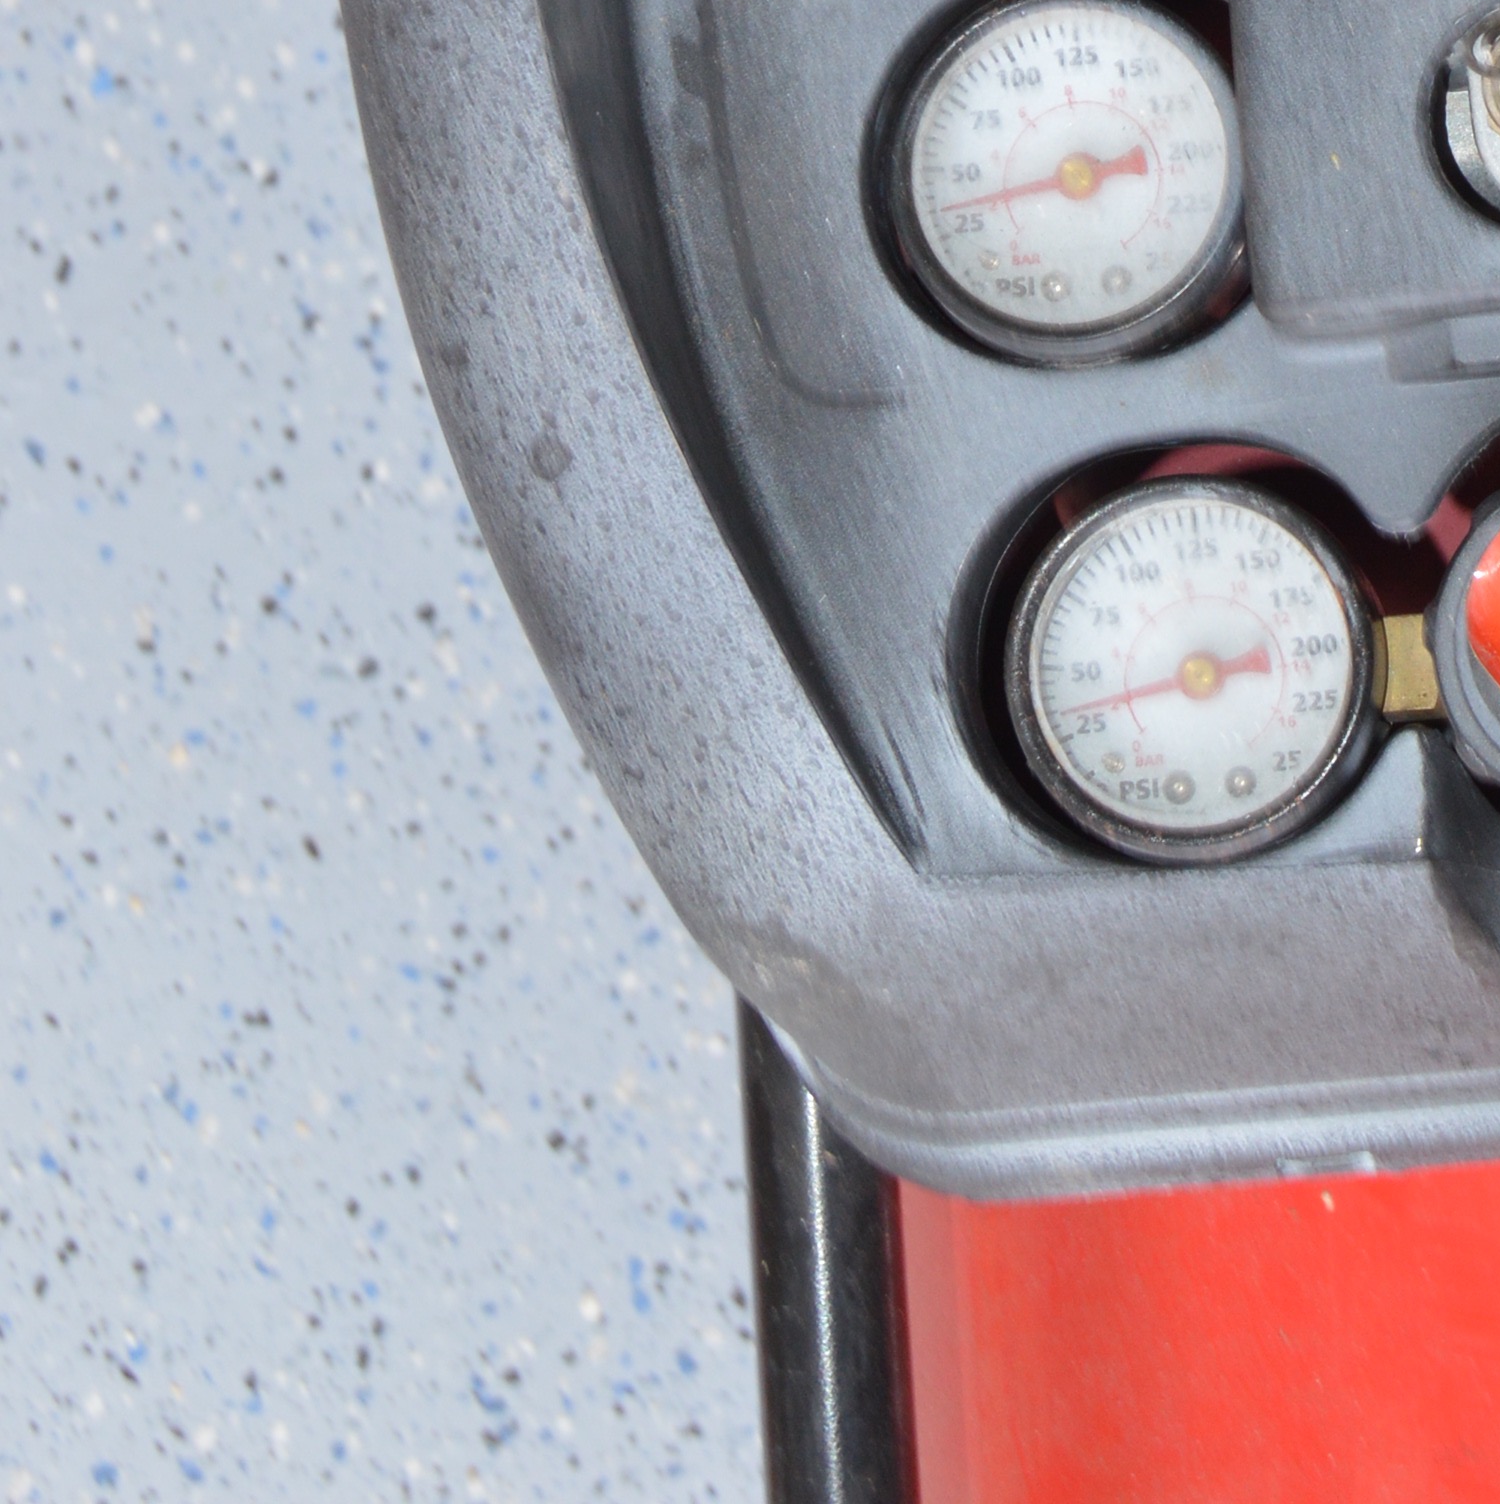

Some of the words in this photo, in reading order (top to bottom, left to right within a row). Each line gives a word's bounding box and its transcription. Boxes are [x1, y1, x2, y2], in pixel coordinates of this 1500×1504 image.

[1053, 47, 1100, 69] 125
[1000, 67, 1043, 89] 100
[951, 162, 981, 183] 50
[953, 213, 985, 235] 25
[1011, 253, 1041, 266] BAR
[1114, 560, 1161, 583] 100
[1235, 549, 1281, 572] 150
[1291, 633, 1339, 657] 200
[1070, 661, 1101, 682] 50
[1291, 689, 1339, 713] 225
[1076, 713, 1107, 735] 25
[1135, 753, 1164, 768] BAR
[1118, 778, 1161, 801] PSI
